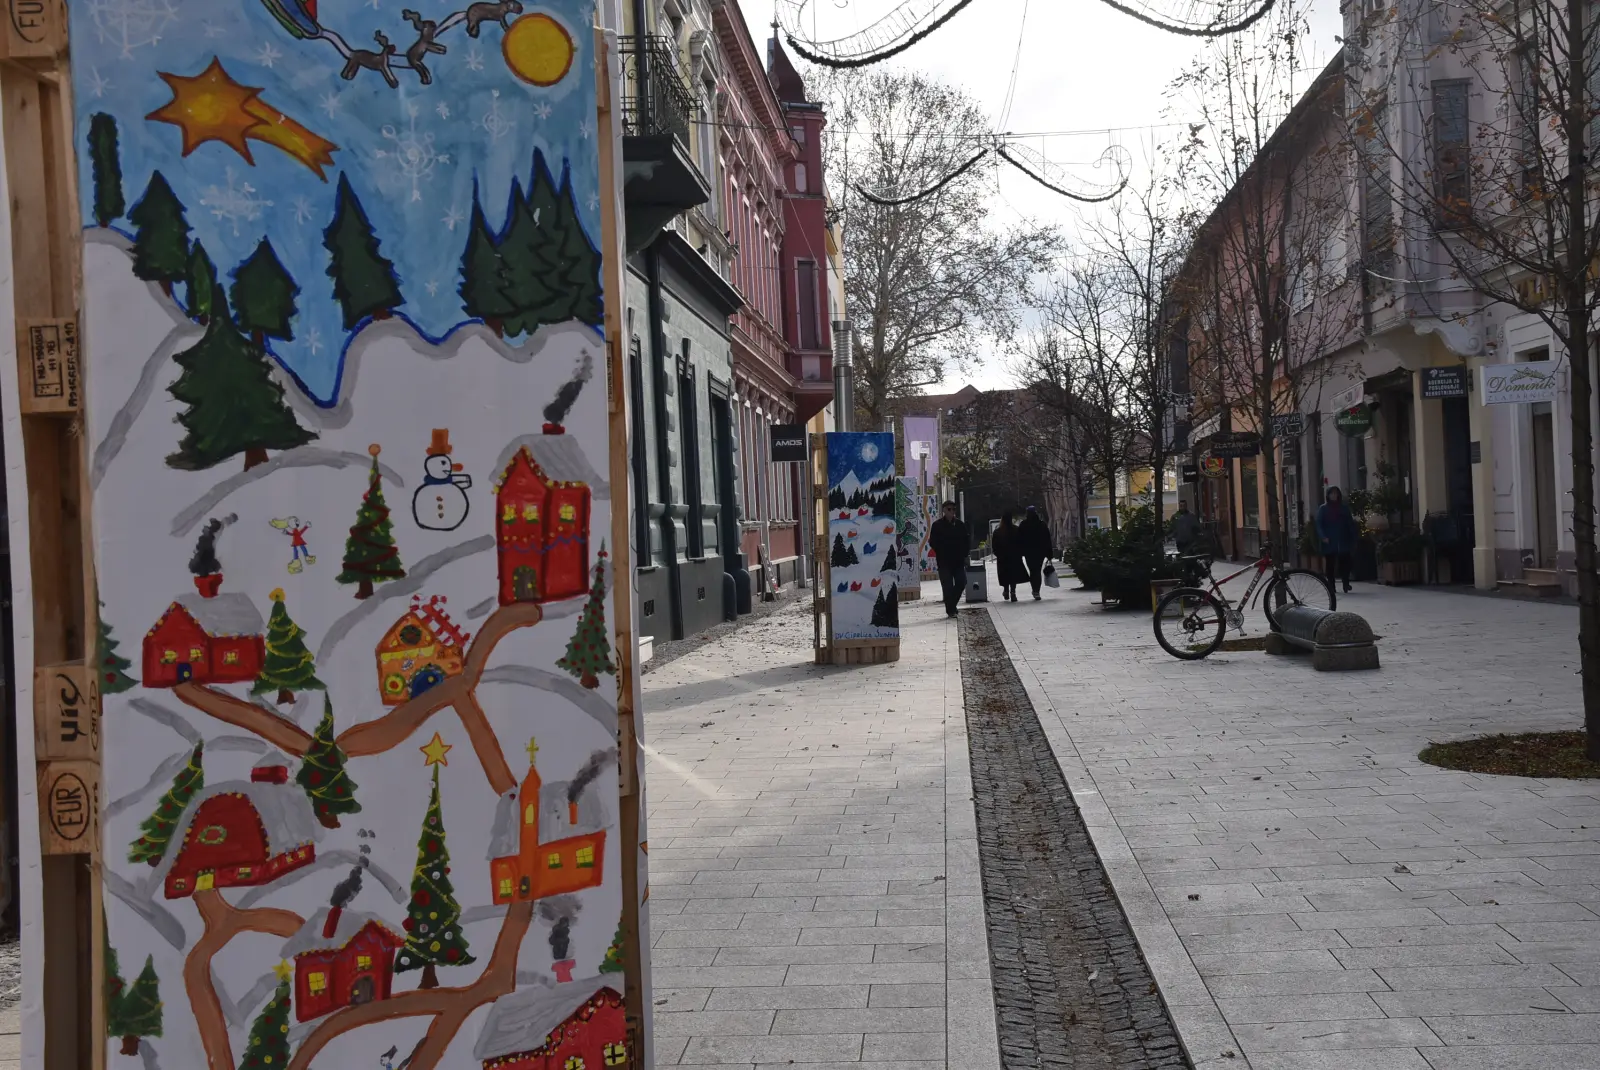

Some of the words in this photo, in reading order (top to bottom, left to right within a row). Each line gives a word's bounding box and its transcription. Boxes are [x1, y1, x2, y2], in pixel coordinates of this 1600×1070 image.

[17, 0, 43, 27] EU
[1486, 376, 1556, 393] Dominik
[1487, 392, 1555, 401] ZLATARNICA
[775, 439, 803, 447] AMOS
[56, 788, 84, 826] EUR
